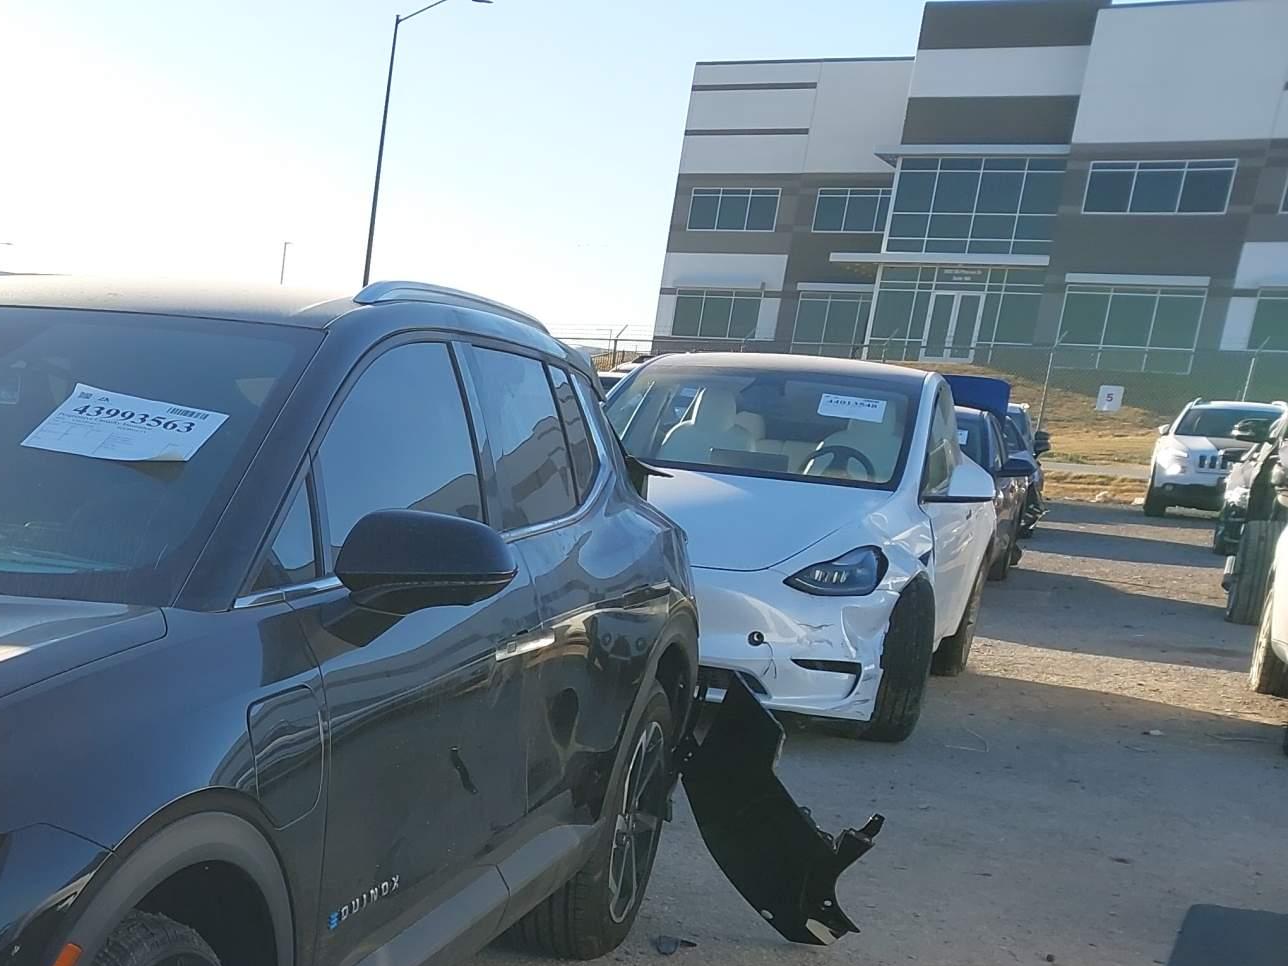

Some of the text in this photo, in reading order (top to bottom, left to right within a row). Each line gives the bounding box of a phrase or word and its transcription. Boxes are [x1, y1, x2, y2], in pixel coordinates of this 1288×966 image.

[1105, 392, 1114, 402] 5
[73, 404, 196, 433] 43993563
[327, 874, 400, 930] EQUINOX
